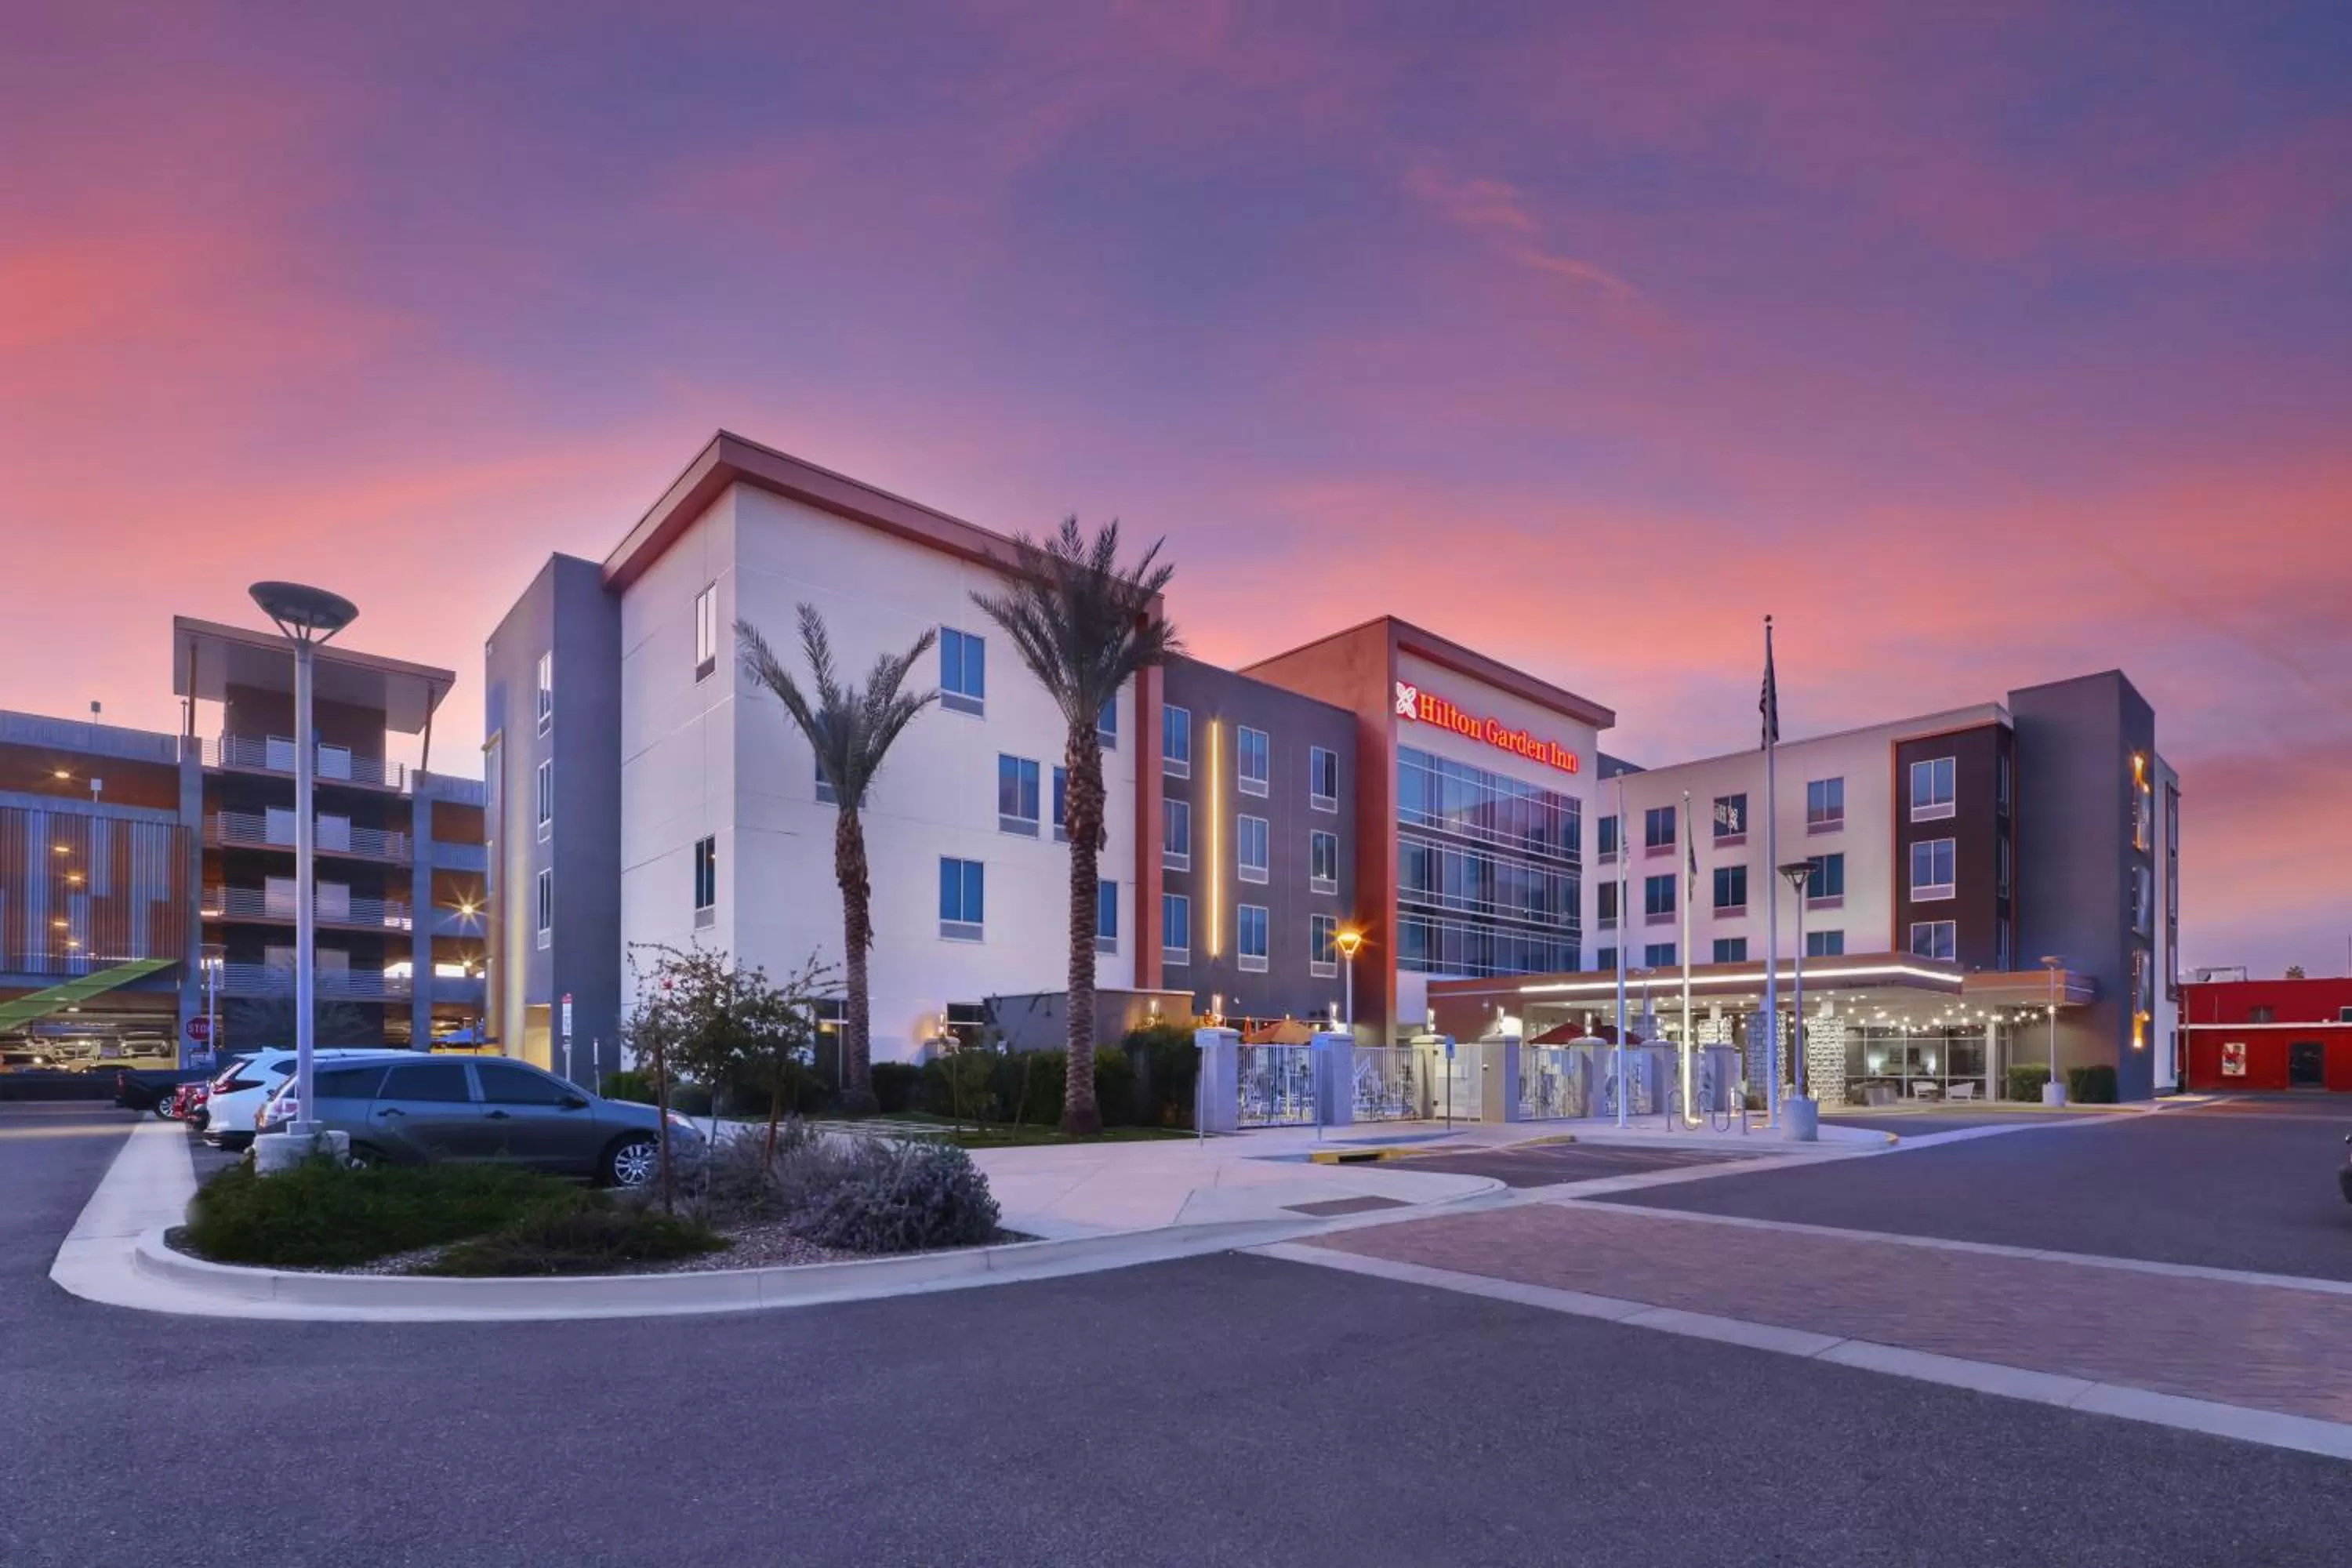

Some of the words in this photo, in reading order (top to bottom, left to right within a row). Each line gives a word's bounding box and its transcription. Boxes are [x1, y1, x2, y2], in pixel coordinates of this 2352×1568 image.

[1419, 693, 1481, 741] Hilton
[1486, 719, 1547, 763] Garden
[1550, 742, 1578, 773] Inn
